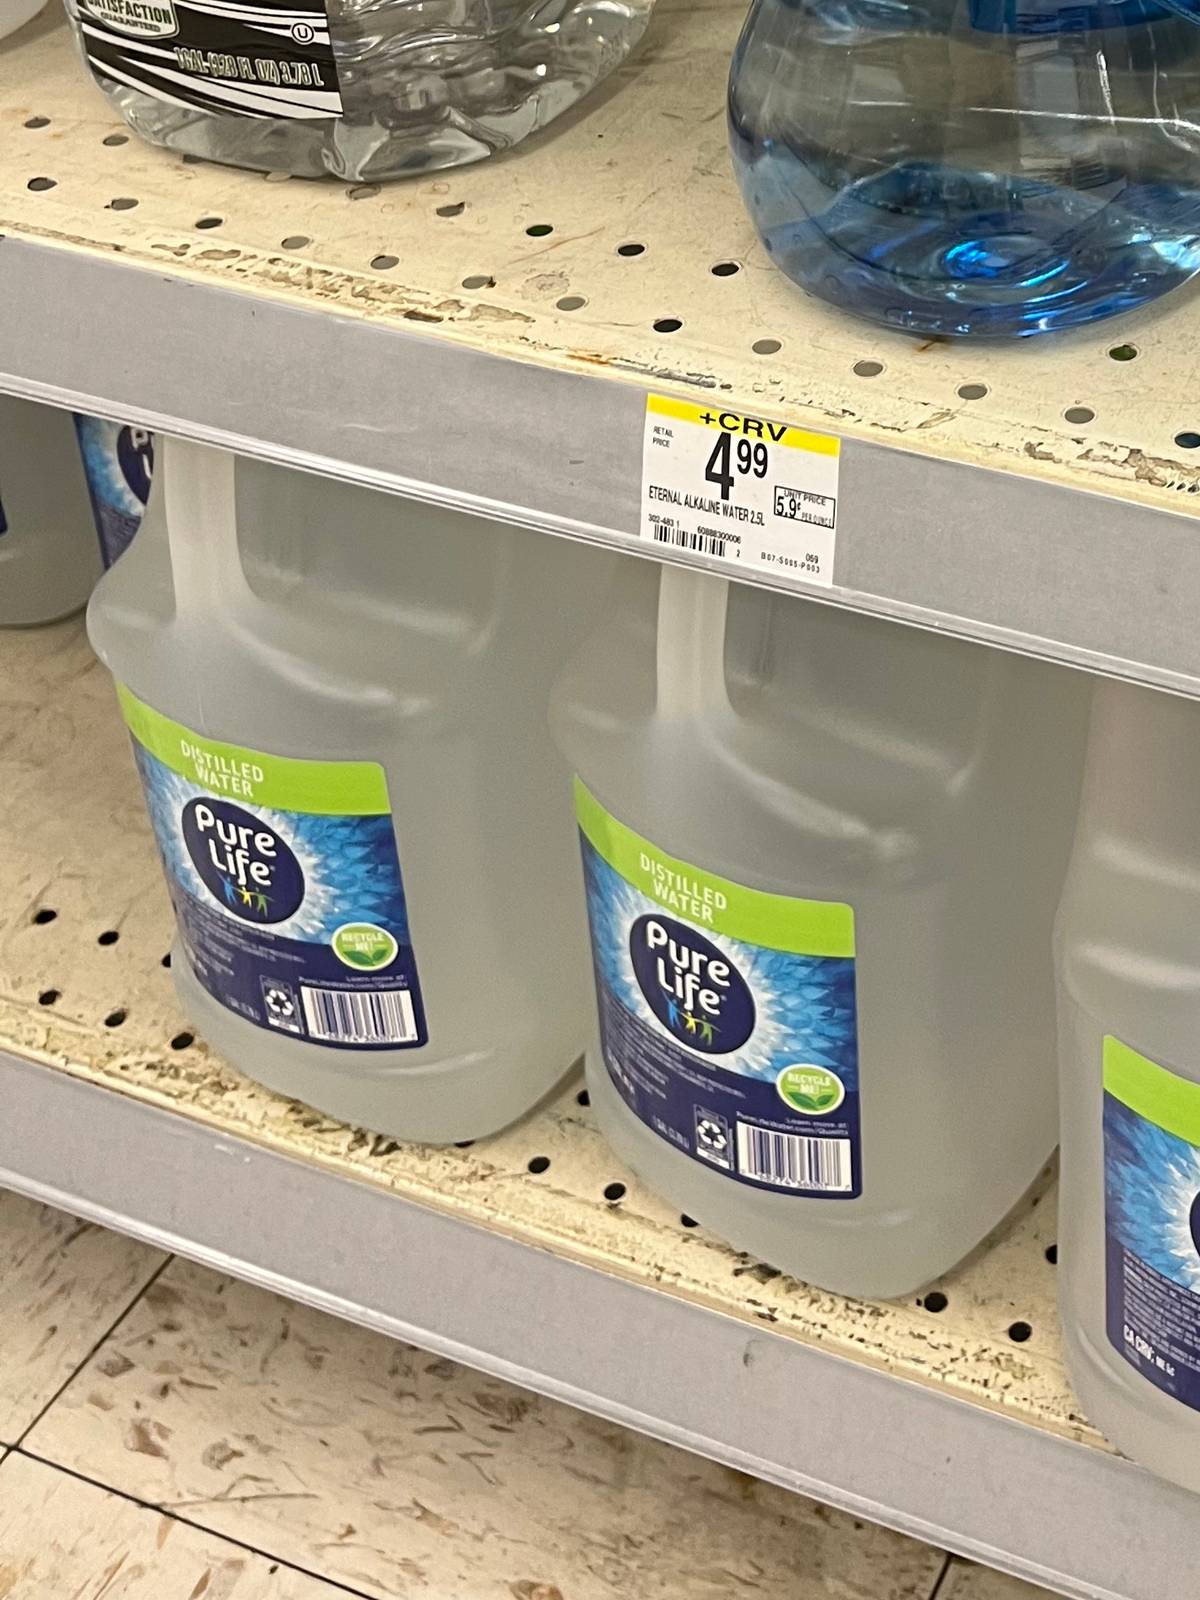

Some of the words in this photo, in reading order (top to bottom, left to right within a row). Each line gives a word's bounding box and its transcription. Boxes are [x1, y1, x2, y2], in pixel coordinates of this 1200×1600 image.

[652, 437, 670, 448] PRICE
[653, 426, 674, 438] RETAIL
[699, 412, 788, 442] +CRV
[705, 431, 735, 501] 4
[737, 439, 768, 478] 99
[649, 485, 682, 505] ETERNAL
[684, 494, 720, 515] ALKALINE
[722, 503, 749, 522] WATER
[750, 510, 765, 526] 2.5L
[803, 494, 826, 506] PRICE
[181, 740, 264, 783] DISTILLED
[195, 759, 254, 797] WATER
[195, 804, 277, 857] Pure
[208, 838, 272, 886] Life
[639, 852, 727, 910] DISTILLED
[653, 878, 713, 924] WATER
[646, 920, 731, 987] Pure
[657, 956, 721, 1015] Life
